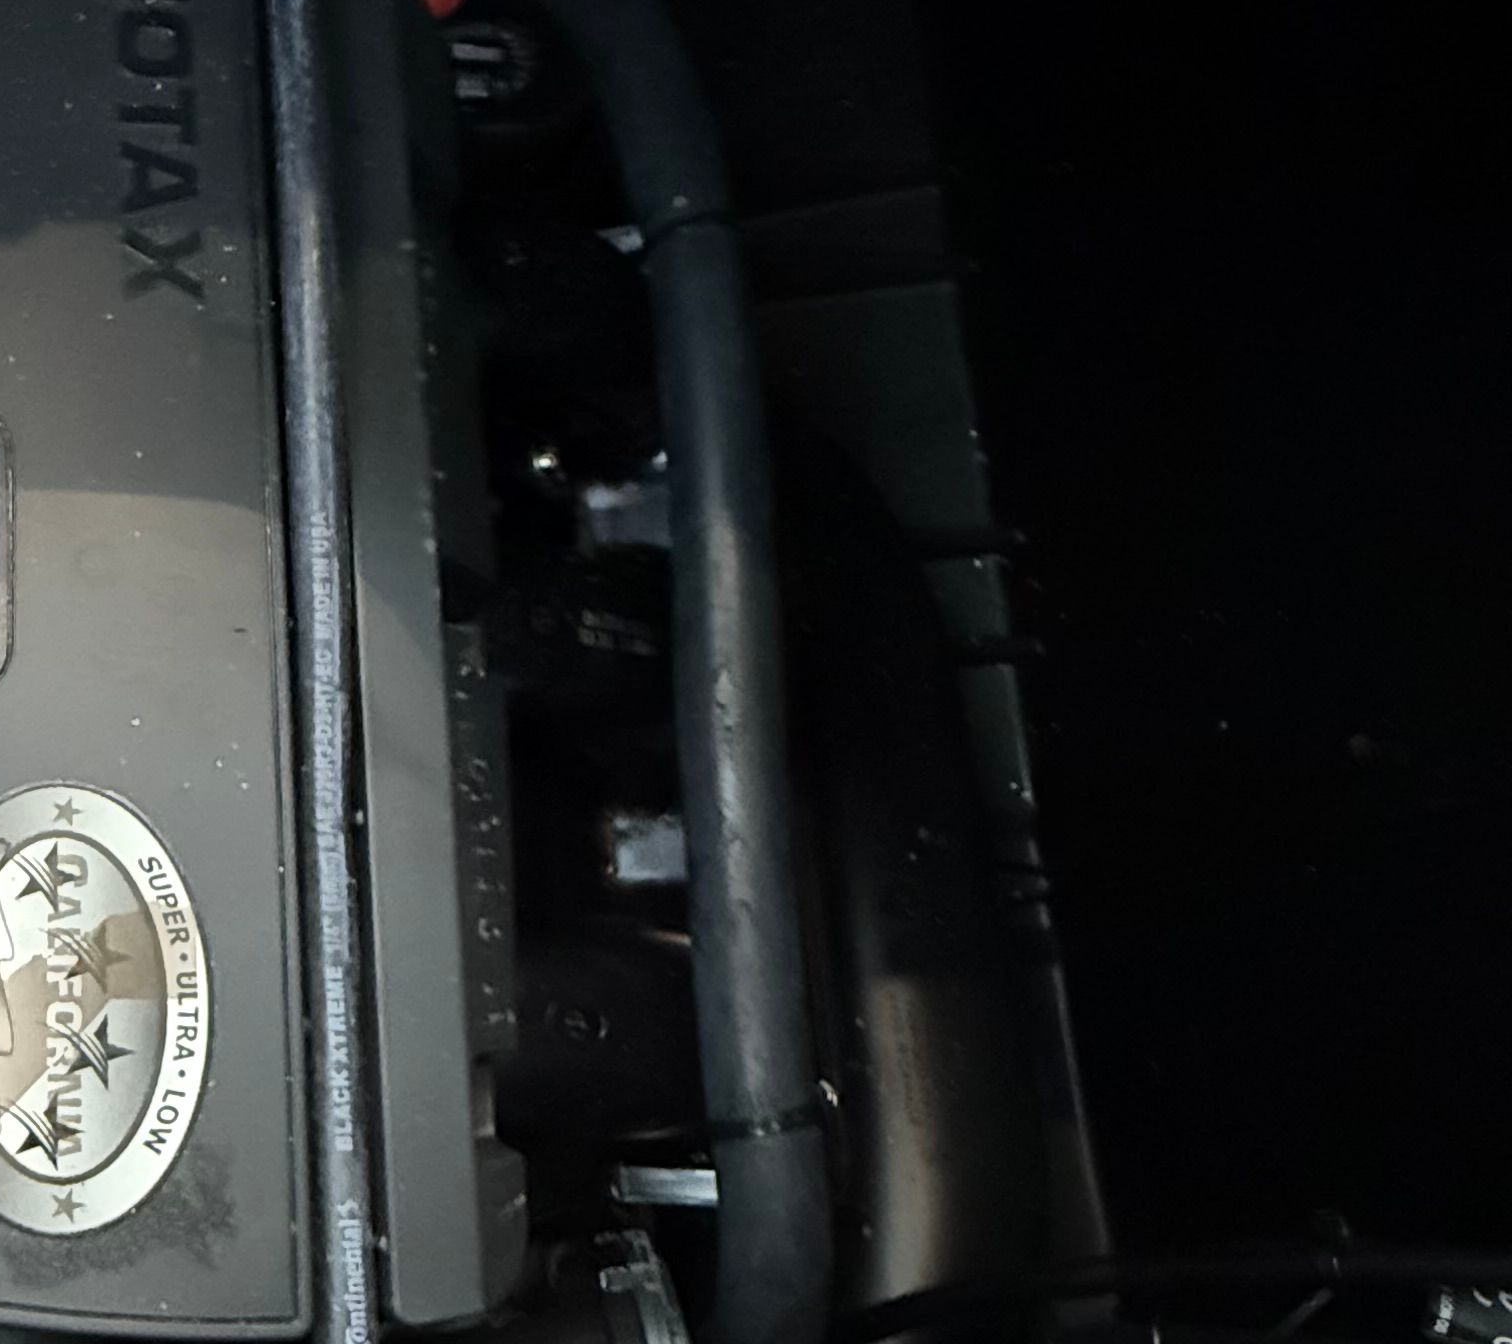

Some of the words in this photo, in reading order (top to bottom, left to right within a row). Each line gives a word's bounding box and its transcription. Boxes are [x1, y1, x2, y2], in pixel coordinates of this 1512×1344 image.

[310, 512, 329, 553] USA
[311, 558, 329, 578] IN
[312, 583, 330, 639] MADE
[138, 855, 194, 946] SUPER
[173, 971, 199, 1064] ULTRA
[325, 964, 350, 1064] XTREME
[141, 1090, 187, 1156] LOW
[330, 1066, 354, 1151] BLACK
